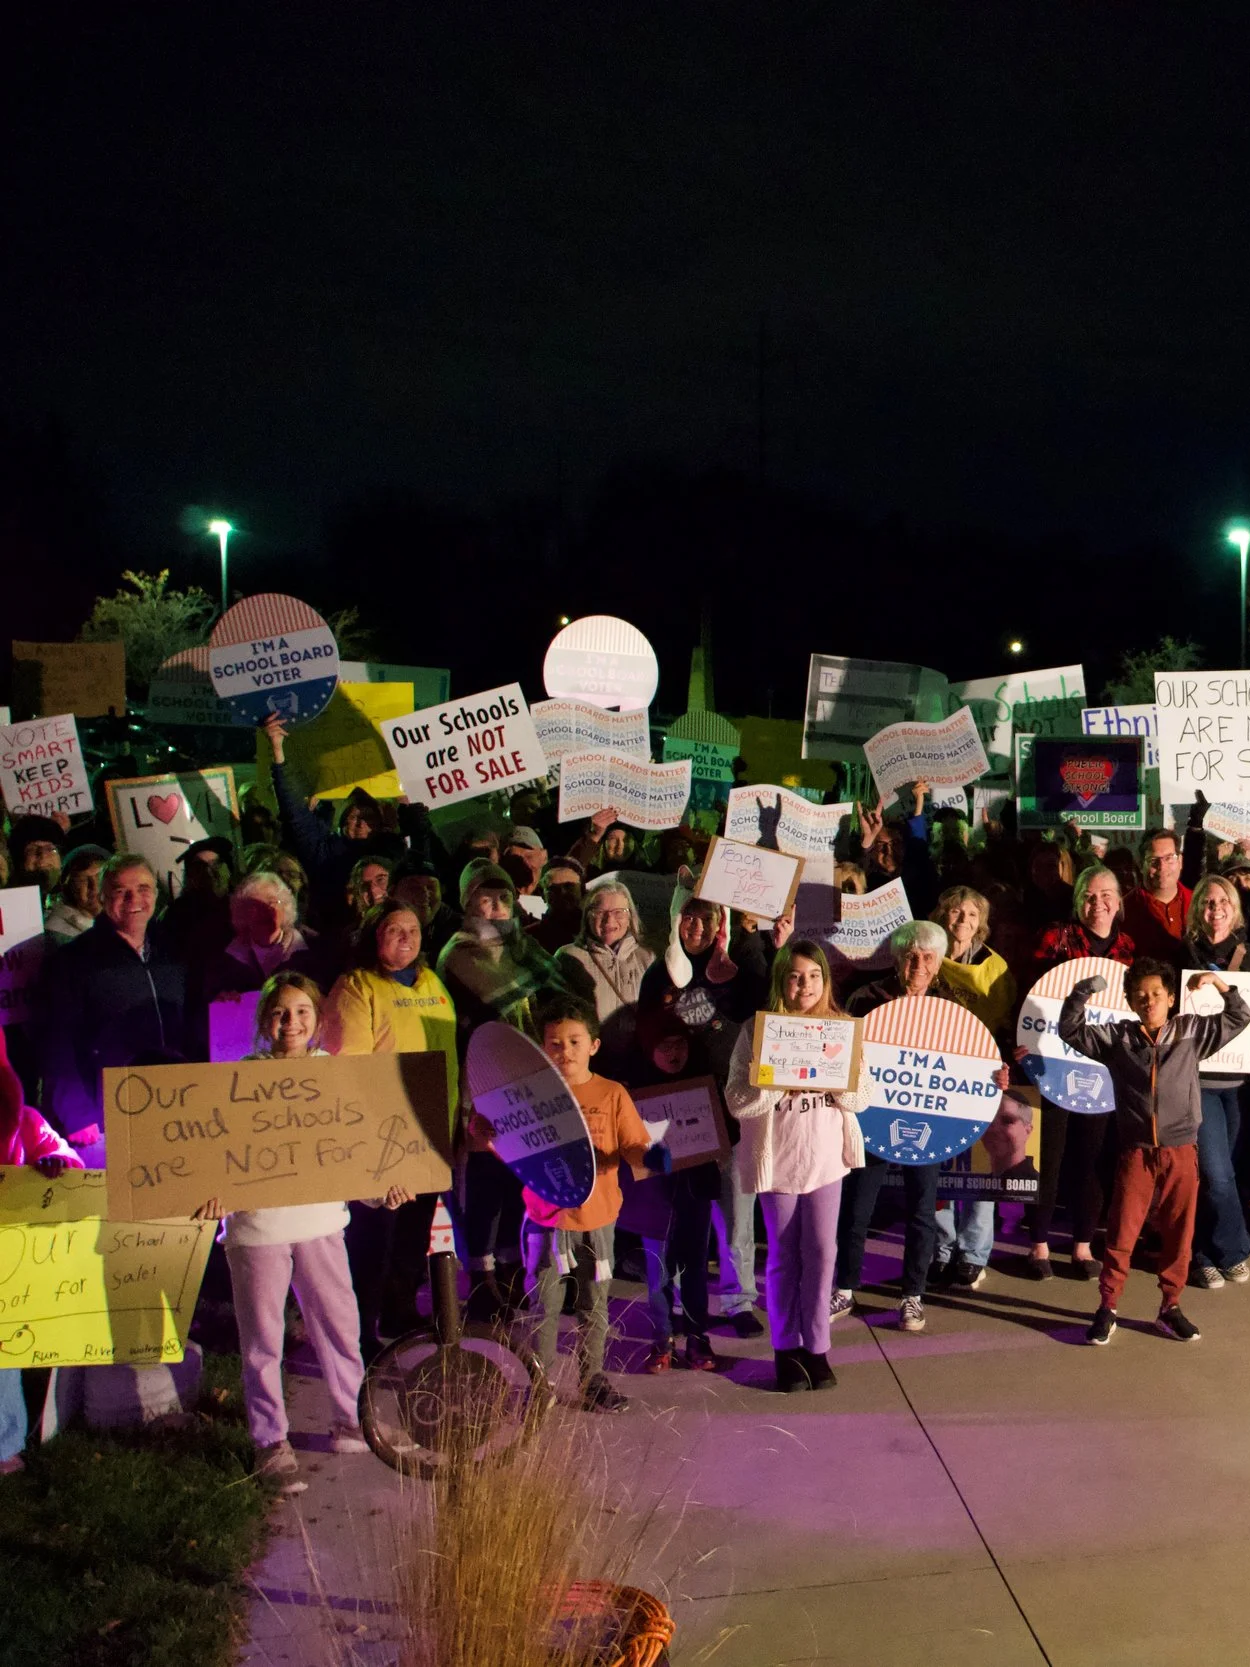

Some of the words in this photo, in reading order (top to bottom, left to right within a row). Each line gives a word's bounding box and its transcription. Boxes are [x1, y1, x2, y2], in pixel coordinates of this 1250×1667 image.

[251, 640, 274, 655] I'M
[278, 638, 289, 650] A
[213, 657, 277, 679] SCHOOL
[281, 644, 334, 664] BOARD
[252, 668, 301, 687] VOTER
[1157, 680, 1198, 708] OUR
[392, 723, 430, 749] Our
[439, 696, 519, 735] Schools
[535, 703, 572, 717] SCHOOL
[575, 704, 610, 722] BOARDS
[612, 712, 645, 723] MATTER
[1, 720, 70, 748] VOTE
[536, 726, 573, 739] SCHOOL
[575, 727, 611, 745] BOARDS
[613, 736, 645, 747] MATTER
[868, 731, 899, 753] SCHOOL
[902, 727, 937, 736] BOARDS
[938, 714, 969, 734] MATTER
[1180, 716, 1233, 743] ARE
[2, 738, 76, 769] SMART
[426, 747, 458, 769] are
[467, 725, 505, 757] NOT
[666, 751, 708, 766] SCHOOL
[694, 742, 711, 754] I'M
[712, 744, 719, 755] A
[876, 754, 908, 777] SCHOOL
[909, 751, 945, 760] BOARDS
[946, 738, 976, 758] MATTER
[14, 758, 69, 785] KEEP
[425, 768, 468, 799] FOR
[475, 750, 526, 784] SALE
[566, 753, 606, 767] SCHOOL
[610, 756, 649, 776] BOARDS
[651, 766, 687, 777] MATTER
[954, 761, 985, 783] MATTER
[1065, 760, 1106, 769] PUBLIC
[1065, 771, 1107, 780] SCHOOL
[1176, 750, 1224, 782] FOR
[19, 773, 74, 803] KIDS
[565, 778, 605, 791] SCHOOL
[608, 780, 648, 800] BOARDS
[649, 790, 685, 801] MATTER
[564, 802, 605, 815] SCHOOL
[733, 790, 774, 803] SCHOOL
[781, 795, 812, 817] OARDS
[812, 808, 847, 820] MATTER
[731, 815, 759, 827] SCHO
[778, 821, 808, 841] OARDS
[1060, 812, 1099, 824] School
[1103, 812, 1137, 824] Board
[1207, 820, 1243, 838] BOARDS
[719, 842, 763, 868] Teach
[738, 878, 774, 897] NOT
[863, 887, 900, 910] MATTER
[824, 925, 869, 938] BOARDS
[870, 915, 907, 937] MATTER
[769, 1055, 787, 1068] Keep
[897, 1050, 928, 1068] I'M
[934, 1056, 947, 1071] A
[115, 1074, 198, 1116] Our
[230, 1071, 321, 1103] Lives
[869, 1066, 922, 1088] HOOL
[928, 1070, 998, 1098] BOARD
[504, 1088, 523, 1106] I'M
[523, 1085, 534, 1099] A
[535, 1092, 575, 1121] BOARD
[884, 1088, 948, 1111] VOTER
[163, 1108, 229, 1143] and
[521, 1125, 561, 1150] VOTER
[130, 1155, 192, 1189] are
[226, 1141, 302, 1174] NOT
[966, 1177, 1004, 1191] SCHOOL
[1006, 1178, 1038, 1192] BOARD
[55, 1278, 88, 1302] for
